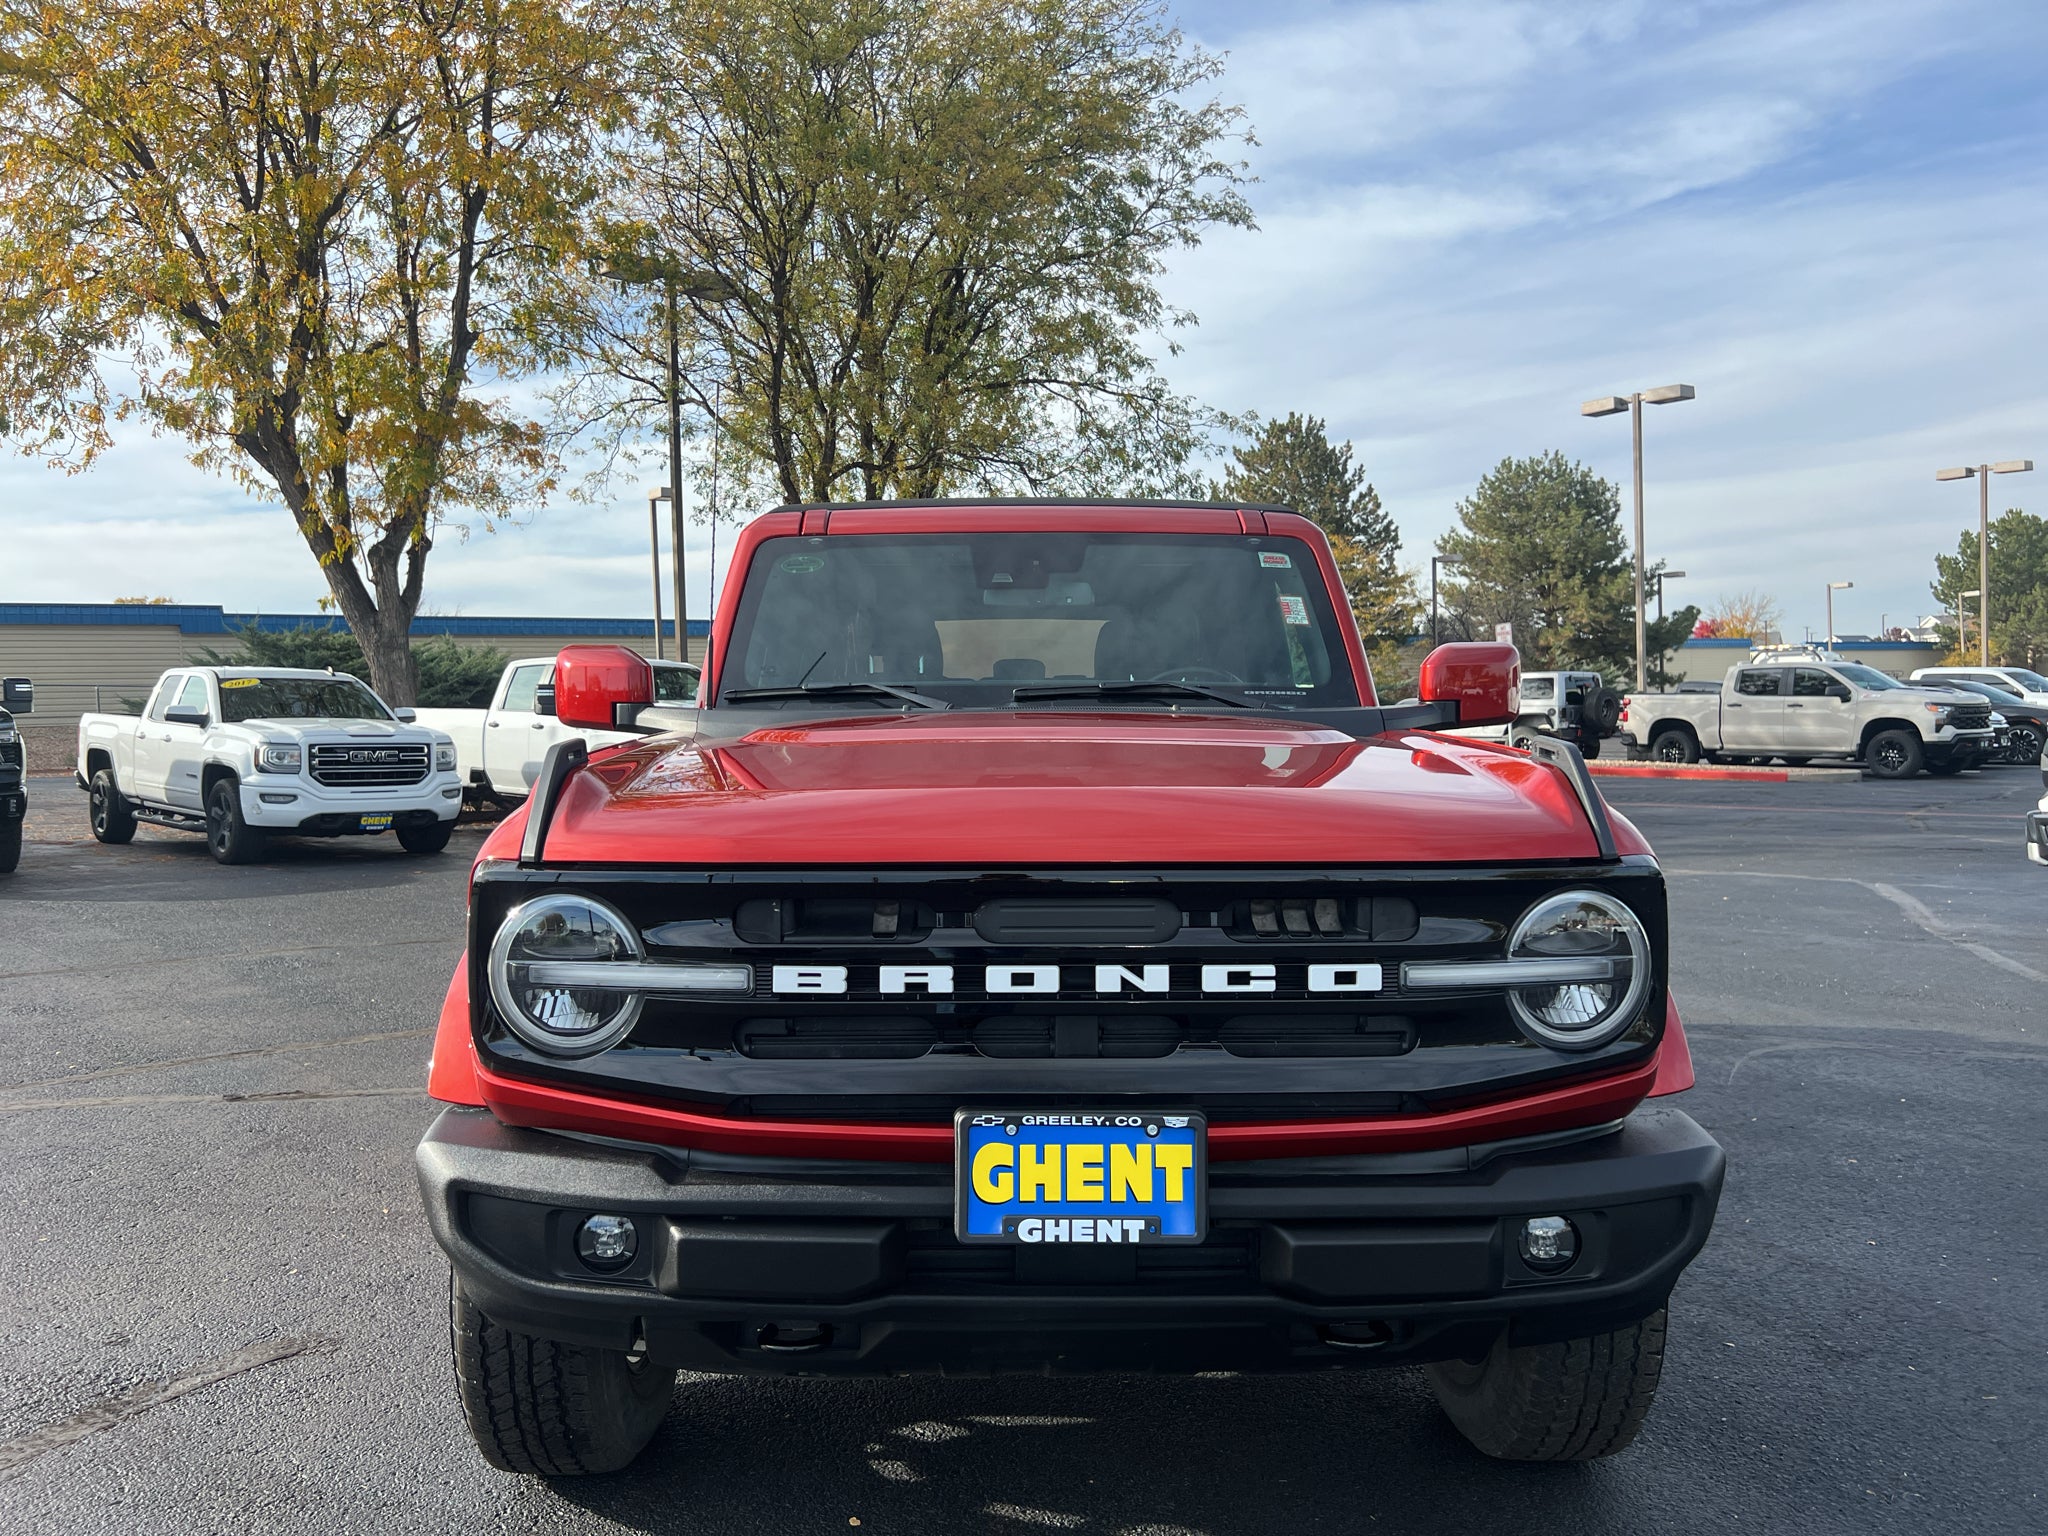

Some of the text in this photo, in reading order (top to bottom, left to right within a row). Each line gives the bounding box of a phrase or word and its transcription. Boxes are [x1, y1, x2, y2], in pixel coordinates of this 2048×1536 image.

[228, 680, 253, 688] 2017
[349, 750, 399, 762] GMC
[361, 816, 393, 825] GHENT
[772, 963, 1383, 994] BRONCO
[1021, 1115, 1143, 1127] GREELEY, CO
[971, 1142, 1193, 1204] GHENT
[1017, 1218, 1146, 1243] GHENT
